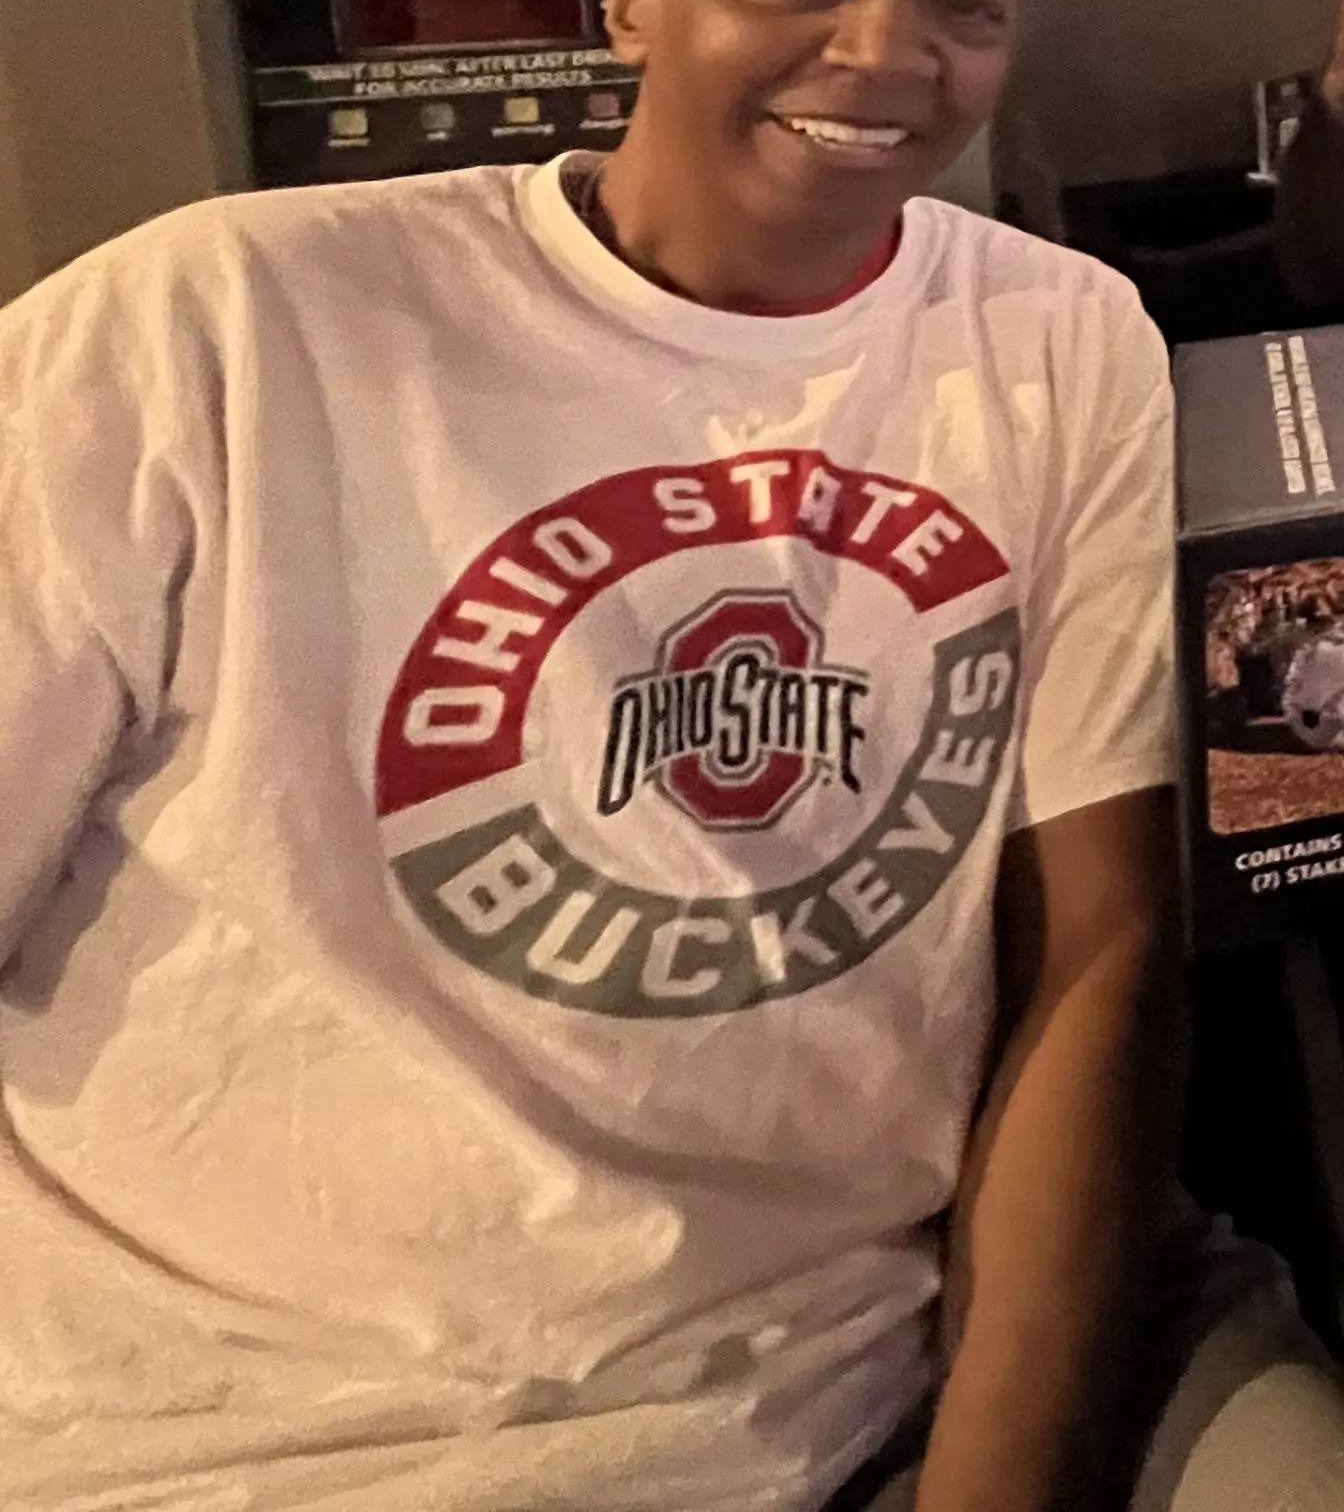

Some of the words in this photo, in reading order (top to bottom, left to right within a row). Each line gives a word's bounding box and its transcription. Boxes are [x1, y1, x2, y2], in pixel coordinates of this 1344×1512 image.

[511, 71, 592, 90] RESULTS
[402, 515, 613, 748] OHIO
[652, 460, 963, 577] STATE
[435, 649, 1014, 998] BUCKEYES
[1235, 833, 1343, 871] CONTAINS
